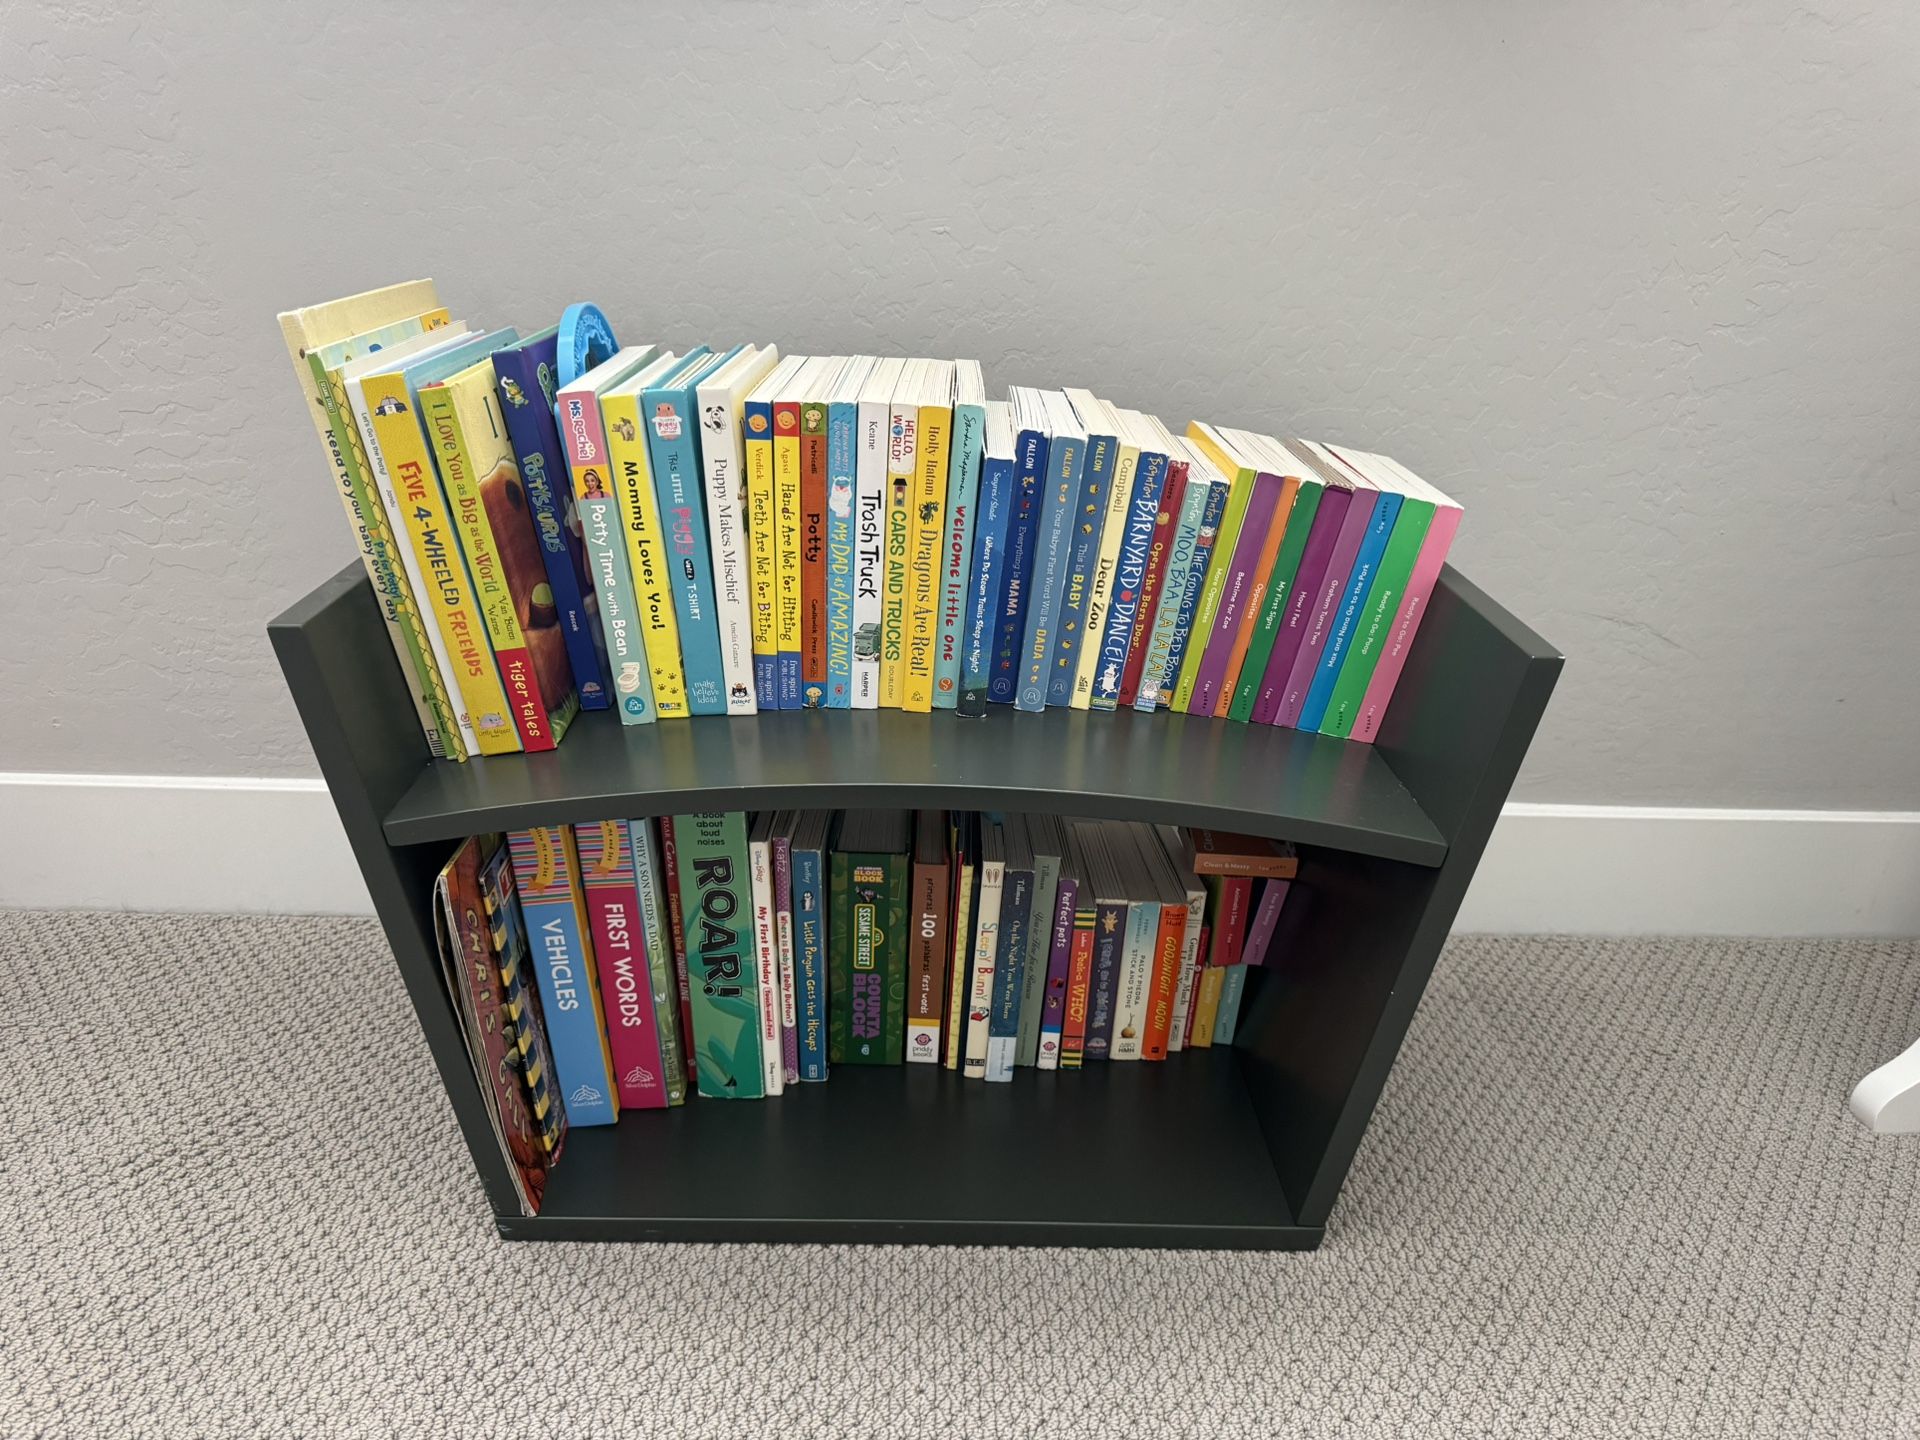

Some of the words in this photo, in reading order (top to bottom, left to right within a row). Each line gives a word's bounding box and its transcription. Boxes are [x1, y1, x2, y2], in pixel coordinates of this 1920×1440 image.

[325, 429, 345, 467] Read
[573, 420, 596, 460] Rachel
[869, 421, 877, 450] Keane
[903, 420, 915, 456] HELLO,
[926, 426, 940, 456] Holly
[782, 447, 790, 474] Agassi
[1026, 439, 1036, 469] FALLON
[1062, 448, 1073, 478] FALLON
[1093, 441, 1106, 472] FALLON
[340, 471, 351, 488] to
[713, 459, 728, 499] Puppy
[925, 460, 937, 495] Hatam
[1113, 458, 1132, 513] Campbell
[344, 491, 365, 521] your
[435, 414, 456, 450] Love
[447, 453, 464, 481] You
[459, 497, 478, 524] Big
[475, 554, 499, 592] World
[754, 490, 768, 526] Teeth
[781, 483, 795, 521] Hands
[861, 490, 881, 542] Trash
[591, 504, 609, 545] Potty
[719, 504, 732, 546] Makes
[1054, 508, 1064, 527] Your
[358, 526, 375, 556] baby
[623, 461, 646, 532] Mommy
[638, 540, 654, 585] Loves
[648, 592, 666, 630] You!
[671, 474, 684, 504] LITTLE
[686, 584, 701, 620] T-SHIRT
[756, 531, 768, 553] Are
[782, 525, 795, 546] Are
[890, 511, 907, 556] CARS
[950, 506, 966, 578] welcome
[984, 536, 994, 560] Where
[1120, 499, 1158, 589] BARNYARD
[1173, 524, 1196, 564] MOO,
[782, 551, 796, 570] Not
[831, 542, 850, 574] DAD
[1012, 526, 1026, 572] Everything
[1150, 543, 1163, 569] Open
[1192, 547, 1207, 571] THE
[371, 560, 391, 595] every
[397, 461, 427, 501] FIVE
[413, 505, 460, 606] 4-WHEELED
[448, 610, 483, 677] FRIENDS
[599, 549, 616, 587] Time
[723, 551, 739, 604] Mischief
[756, 556, 770, 576] Not
[858, 546, 879, 598] Truck
[888, 561, 904, 594] AND
[912, 529, 937, 602] Dragons
[1095, 558, 1114, 598] Dear
[758, 580, 770, 599] for
[782, 575, 796, 593] for
[980, 574, 989, 595] Steam
[1007, 580, 1021, 616] MAMA
[1069, 575, 1084, 609] BABY
[1145, 576, 1156, 590] the
[1164, 568, 1186, 604] BAA,
[1181, 573, 1202, 608] GOING
[1230, 571, 1244, 602] Bedtime
[1323, 580, 1339, 609] Graham
[385, 600, 399, 623] day
[606, 594, 619, 616] with
[945, 583, 961, 626] little
[977, 598, 986, 618] Trains
[1089, 602, 1104, 630] Zoo
[1138, 595, 1151, 620] Barn
[1202, 587, 1218, 623] Opposites
[1248, 584, 1264, 620] Opposites
[1272, 594, 1282, 610] First
[1328, 652, 1336, 667] Max
[1340, 616, 1350, 636] Nana
[1359, 564, 1369, 580] Park
[1377, 590, 1391, 613] Ready
[1406, 597, 1419, 620] Ready
[756, 602, 771, 642] Biting
[780, 597, 796, 641] Hitting
[830, 588, 849, 676] AMAZING!
[885, 599, 902, 661] TRUCKS
[913, 605, 933, 634] Are
[973, 620, 984, 638] Sleep
[1104, 602, 1135, 662] DANCE!
[1159, 607, 1178, 628] LA
[1265, 611, 1276, 630] Signs
[1291, 613, 1300, 627] Feel
[1316, 612, 1327, 631] Turns
[612, 620, 628, 656] Bean
[944, 635, 954, 661] one
[1033, 629, 1047, 659] DADA
[1154, 632, 1171, 649] LA
[1170, 626, 1188, 652] BED
[1311, 633, 1321, 645] Two
[1362, 637, 1373, 655] Poop
[910, 636, 931, 677] Real!
[969, 650, 980, 673] Night?
[1146, 652, 1166, 679] LA!
[1160, 656, 1178, 686] BOOK
[508, 660, 529, 697] tiger
[521, 701, 540, 737] tales
[789, 677, 797, 698] spirit
[701, 829, 720, 837] loud
[665, 841, 676, 876] Cars
[644, 891, 656, 921] NEEDS
[1015, 880, 1024, 905] Tillman
[670, 893, 679, 924] Friends
[758, 906, 767, 921] My
[859, 908, 870, 936] SESAME
[1061, 892, 1072, 925] Perfect
[604, 904, 630, 950] FIRST
[692, 856, 742, 997] ROAR!
[760, 924, 768, 944] First
[803, 920, 816, 945] Little
[922, 912, 937, 938] 100
[1056, 927, 1067, 948] pets
[802, 947, 817, 978] Penguin
[859, 938, 870, 966] STREET
[1009, 946, 1018, 966] Night
[1189, 938, 1198, 957] Guess
[542, 918, 579, 1012] VEHICLES
[761, 947, 771, 985] Birthday
[1160, 936, 1176, 996] GOODNIGHT
[1186, 963, 1194, 980] How
[613, 957, 642, 1027] WORDS
[783, 974, 791, 992] Belly
[806, 981, 815, 999] Gets
[921, 975, 931, 992] first
[1134, 979, 1143, 1005] PIEDRA
[783, 994, 793, 1023] Button?
[807, 1002, 817, 1016] the
[921, 993, 929, 1014] words
[1071, 984, 1087, 1022] WHO?
[1154, 1000, 1167, 1031] MOON
[805, 1019, 819, 1052] Hiccups
